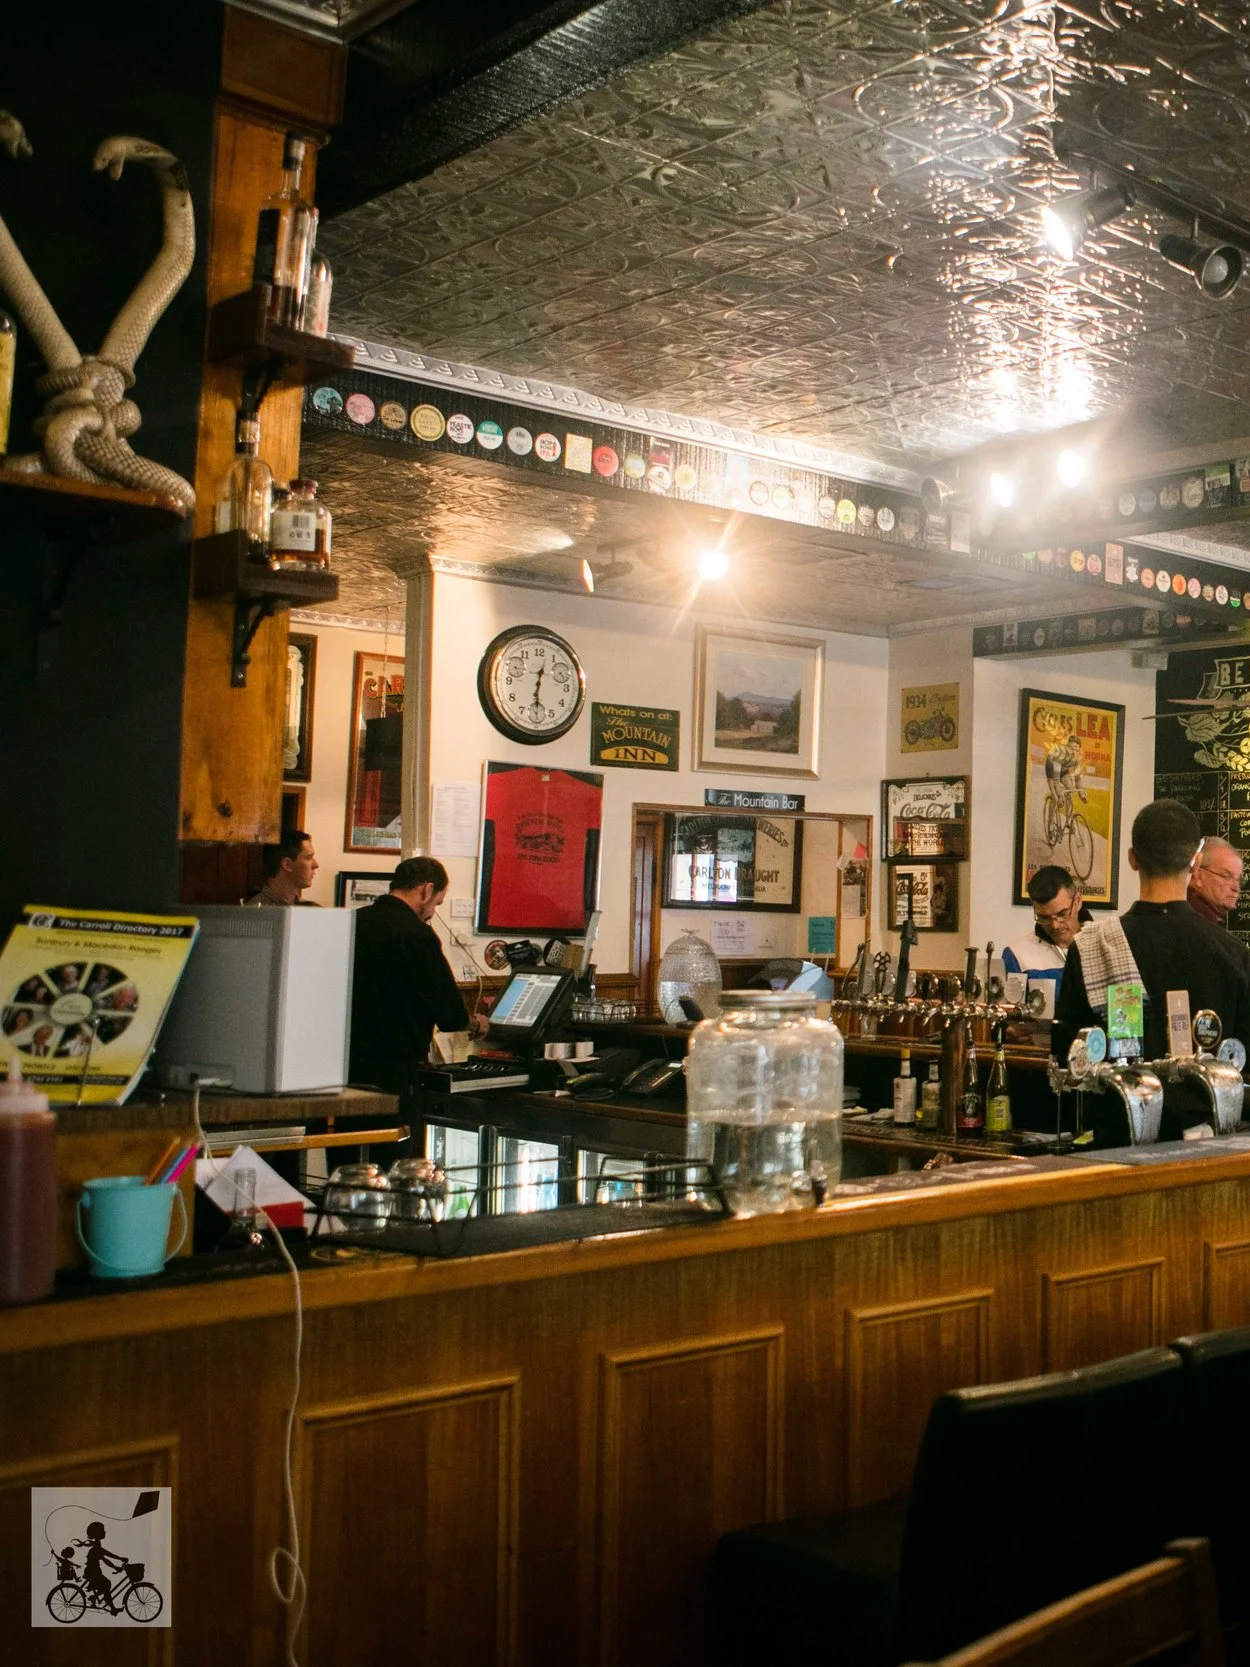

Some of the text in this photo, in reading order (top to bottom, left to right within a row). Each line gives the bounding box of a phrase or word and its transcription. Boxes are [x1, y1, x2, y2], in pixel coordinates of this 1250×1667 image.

[520, 650, 530, 660] 11
[534, 648, 545, 658] 12
[505, 676, 513, 686] 9
[562, 683, 570, 693] 3
[508, 693, 516, 703] 8
[558, 698, 565, 708] 4
[906, 694, 927, 709] 1934
[518, 706, 526, 715] 7
[548, 709, 555, 719] 5
[600, 705, 673, 721] Whats on at:
[606, 716, 629, 726] The
[1076, 711, 1111, 742] LEA
[602, 726, 671, 749] MOUNTAIN
[614, 747, 656, 762] INN
[717, 792, 798, 810] The Mountain Bar
[689, 865, 780, 883] CARLTON DRAUGHT
[59, 918, 184, 936] The Carroll Directory 2017
